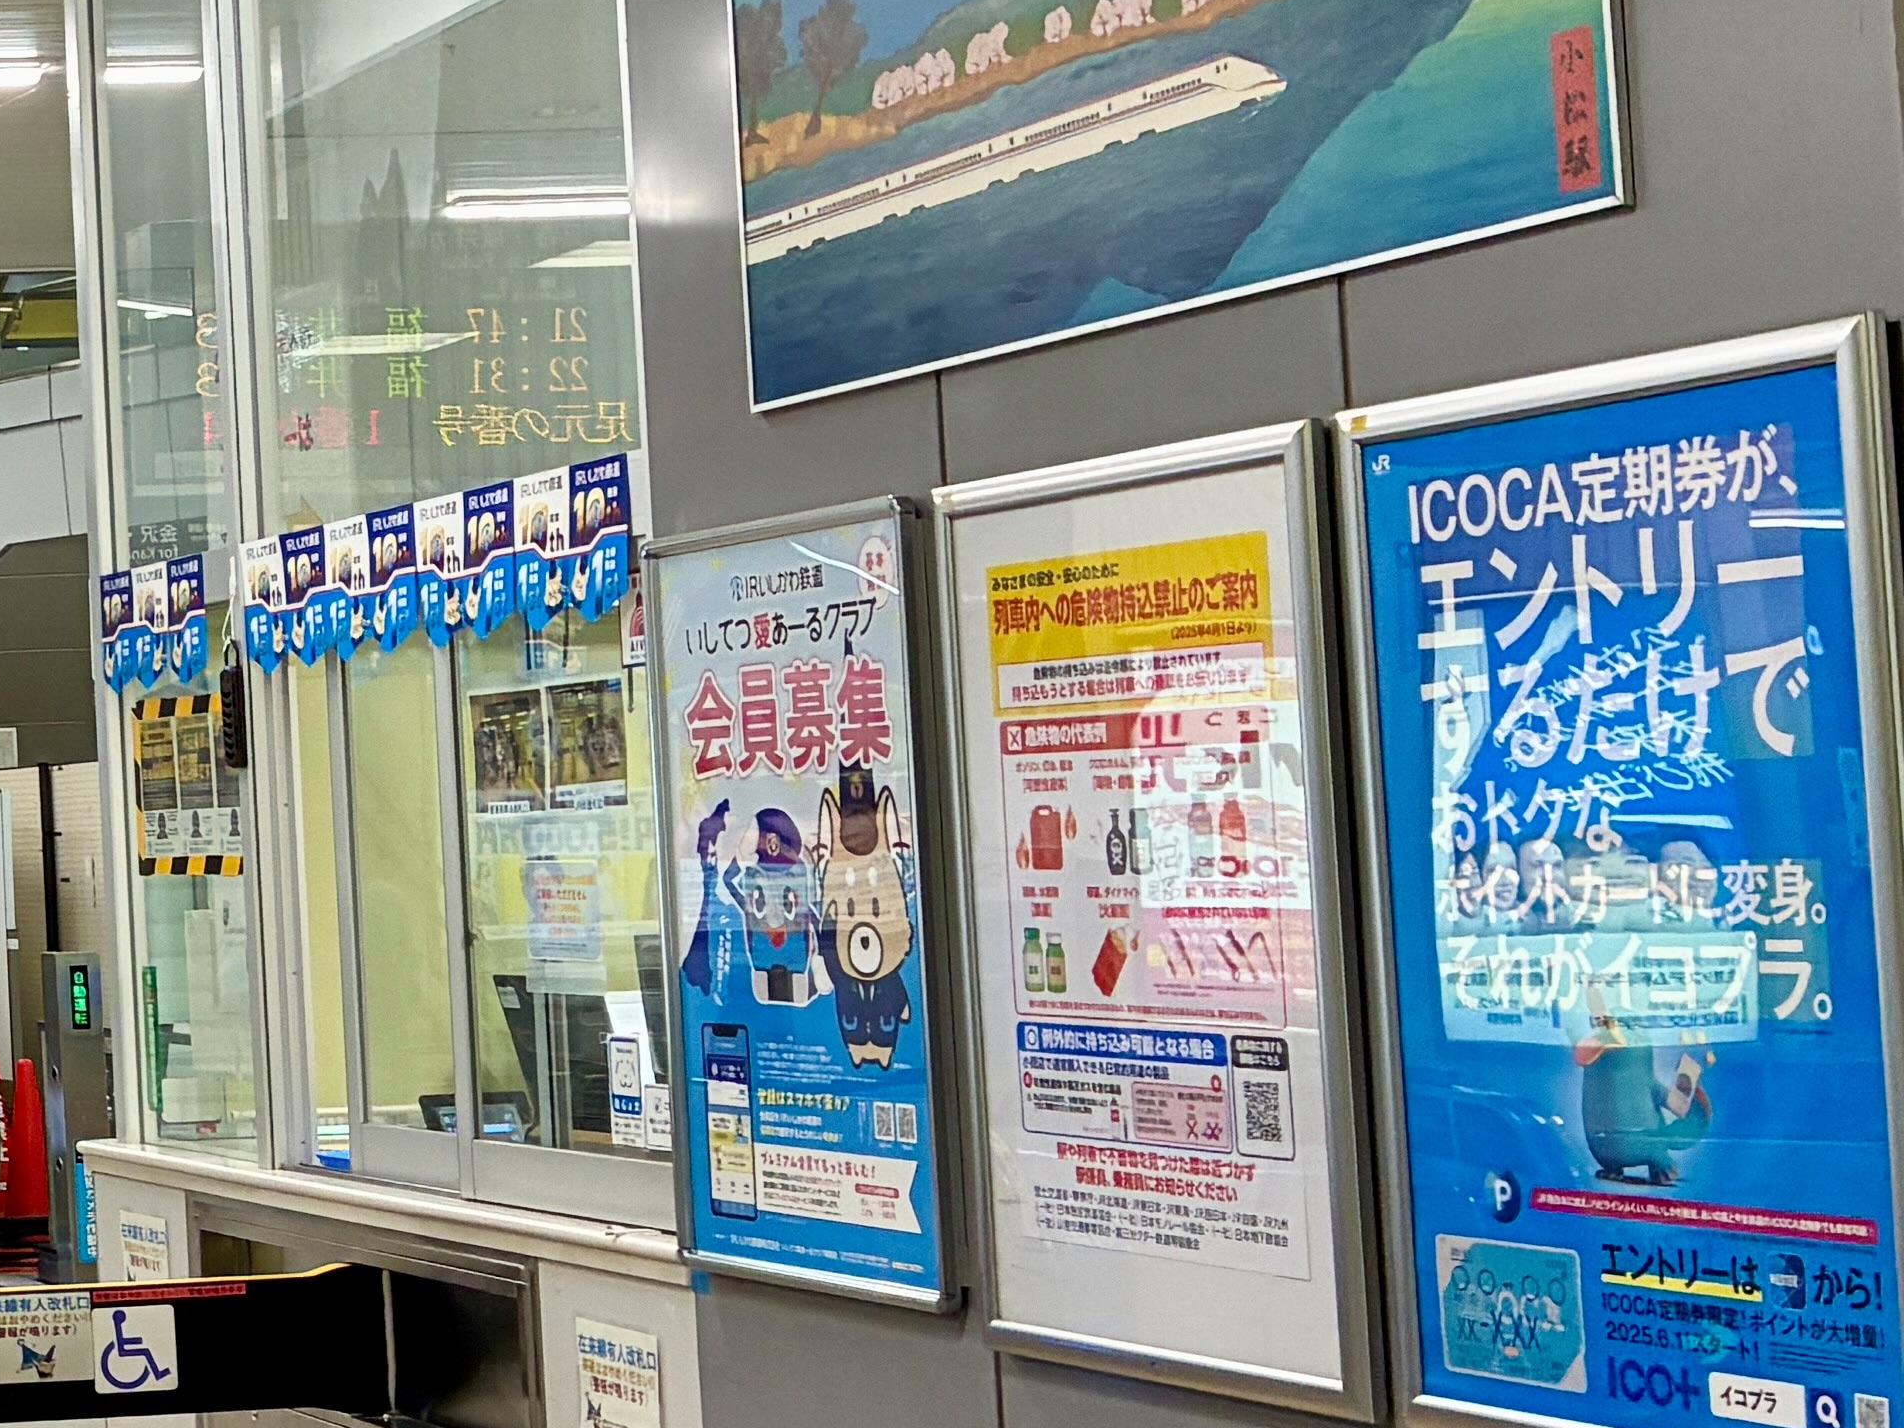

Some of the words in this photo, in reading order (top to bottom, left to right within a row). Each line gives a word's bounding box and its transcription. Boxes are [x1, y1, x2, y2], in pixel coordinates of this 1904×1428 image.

[1409, 422, 1799, 545] ICOCA定期券が、
[1418, 519, 1805, 651] エントリー
[686, 655, 894, 782] 会員募集
[1601, 1242, 1763, 1295] エントリーは
